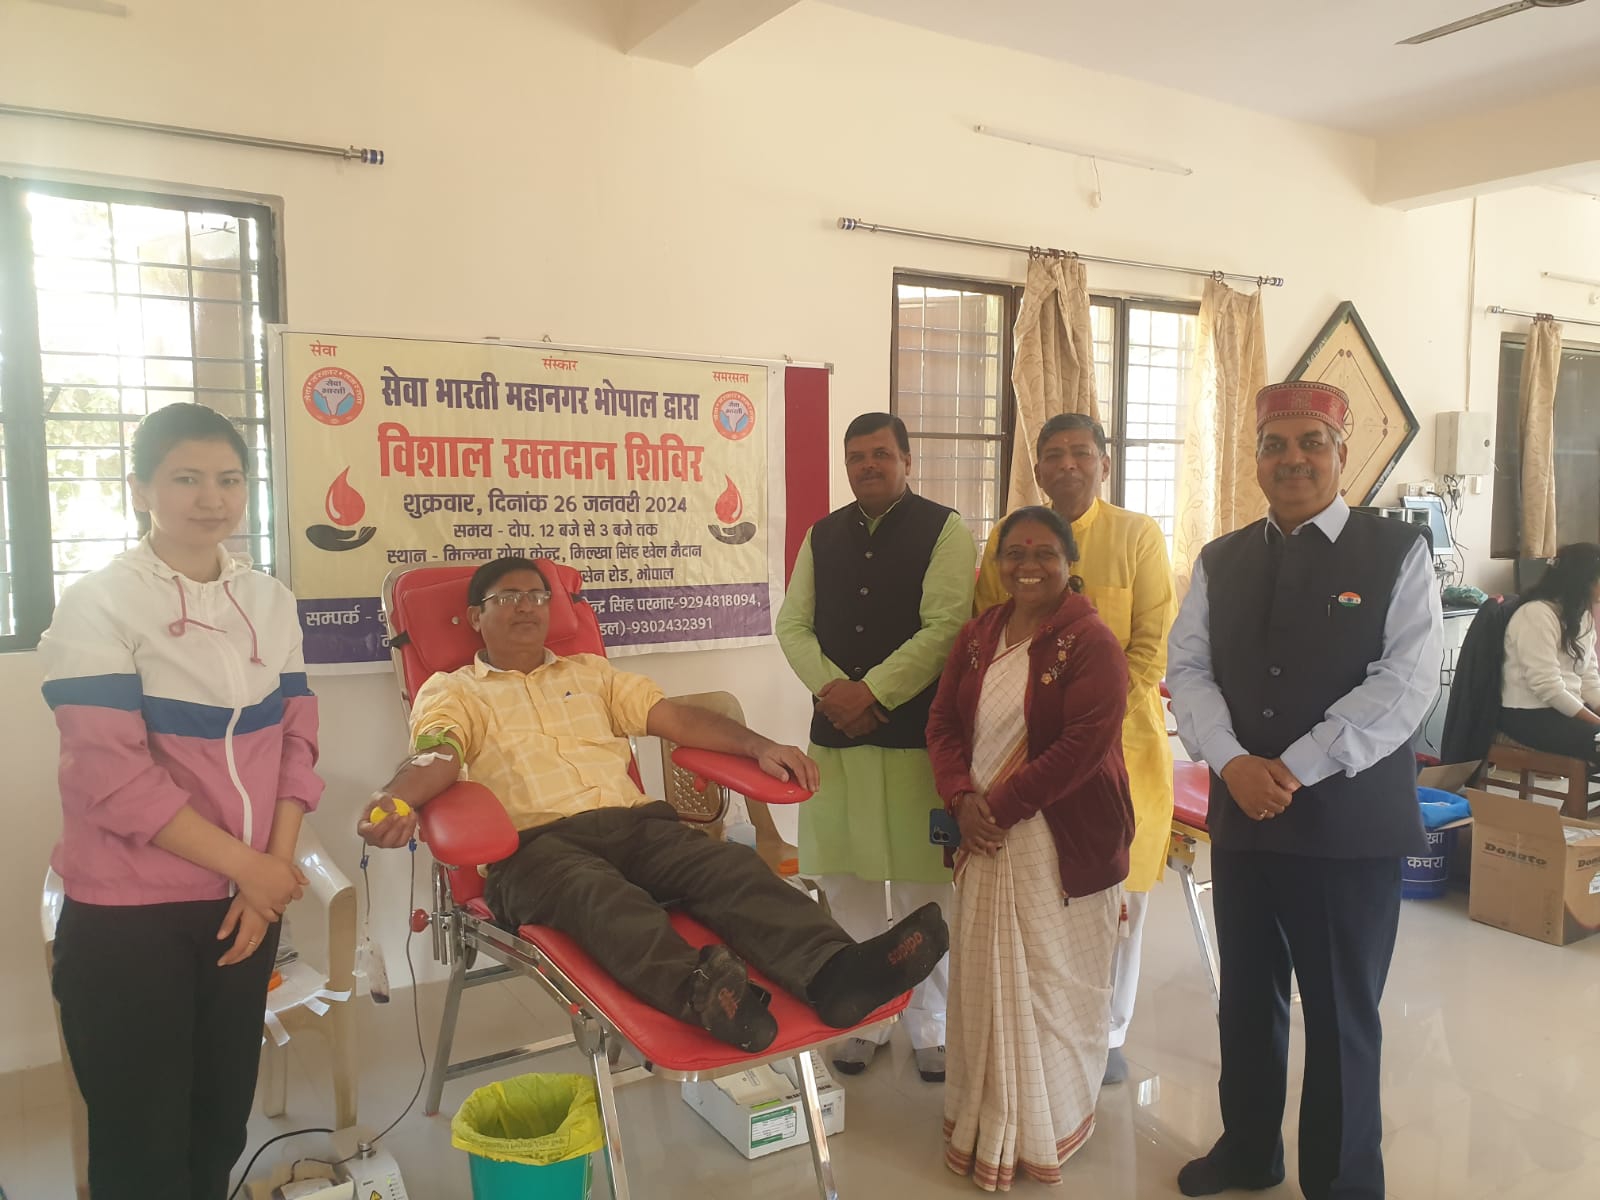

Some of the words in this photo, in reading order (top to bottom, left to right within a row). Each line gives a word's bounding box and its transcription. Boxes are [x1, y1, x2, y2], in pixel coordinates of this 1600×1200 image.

[310, 340, 337, 357] सेवा
[542, 356, 578, 372] संस्कार
[712, 371, 749, 384] समरसता
[380, 366, 429, 407] सेवा
[435, 372, 499, 410] भारती
[505, 382, 589, 415] महानगर
[594, 379, 658, 418] भोपाल
[663, 392, 700, 421] द्वारा
[377, 422, 494, 478] विशाल
[502, 438, 618, 480] रक्तदान
[625, 431, 705, 482] शिविर
[403, 494, 482, 518] शुक्रवार,
[488, 488, 548, 512] दिनांक
[554, 495, 577, 513] 26
[583, 490, 641, 513] जनवरी
[645, 496, 688, 513] 2024
[453, 524, 492, 538] समय
[508, 519, 535, 538] दोप.
[540, 524, 554, 537] 12
[559, 519, 580, 537] बजे
[584, 519, 596, 537] से
[600, 524, 608, 537] 3
[613, 519, 633, 537] बजे
[636, 523, 658, 537] तक
[387, 549, 427, 564] स्थान
[570, 542, 612, 561] मिल्खा
[616, 542, 639, 559] सिंह
[643, 541, 667, 558] खेल
[671, 540, 702, 558] मैदान
[608, 564, 633, 583] रोड,
[636, 564, 675, 581] भोपाल
[609, 595, 633, 612] सिंह
[305, 604, 360, 626] सम्पर्क
[599, 617, 712, 637] डल)-9302432391
[1426, 831, 1444, 845] खा
[1406, 856, 1445, 869] कचरा
